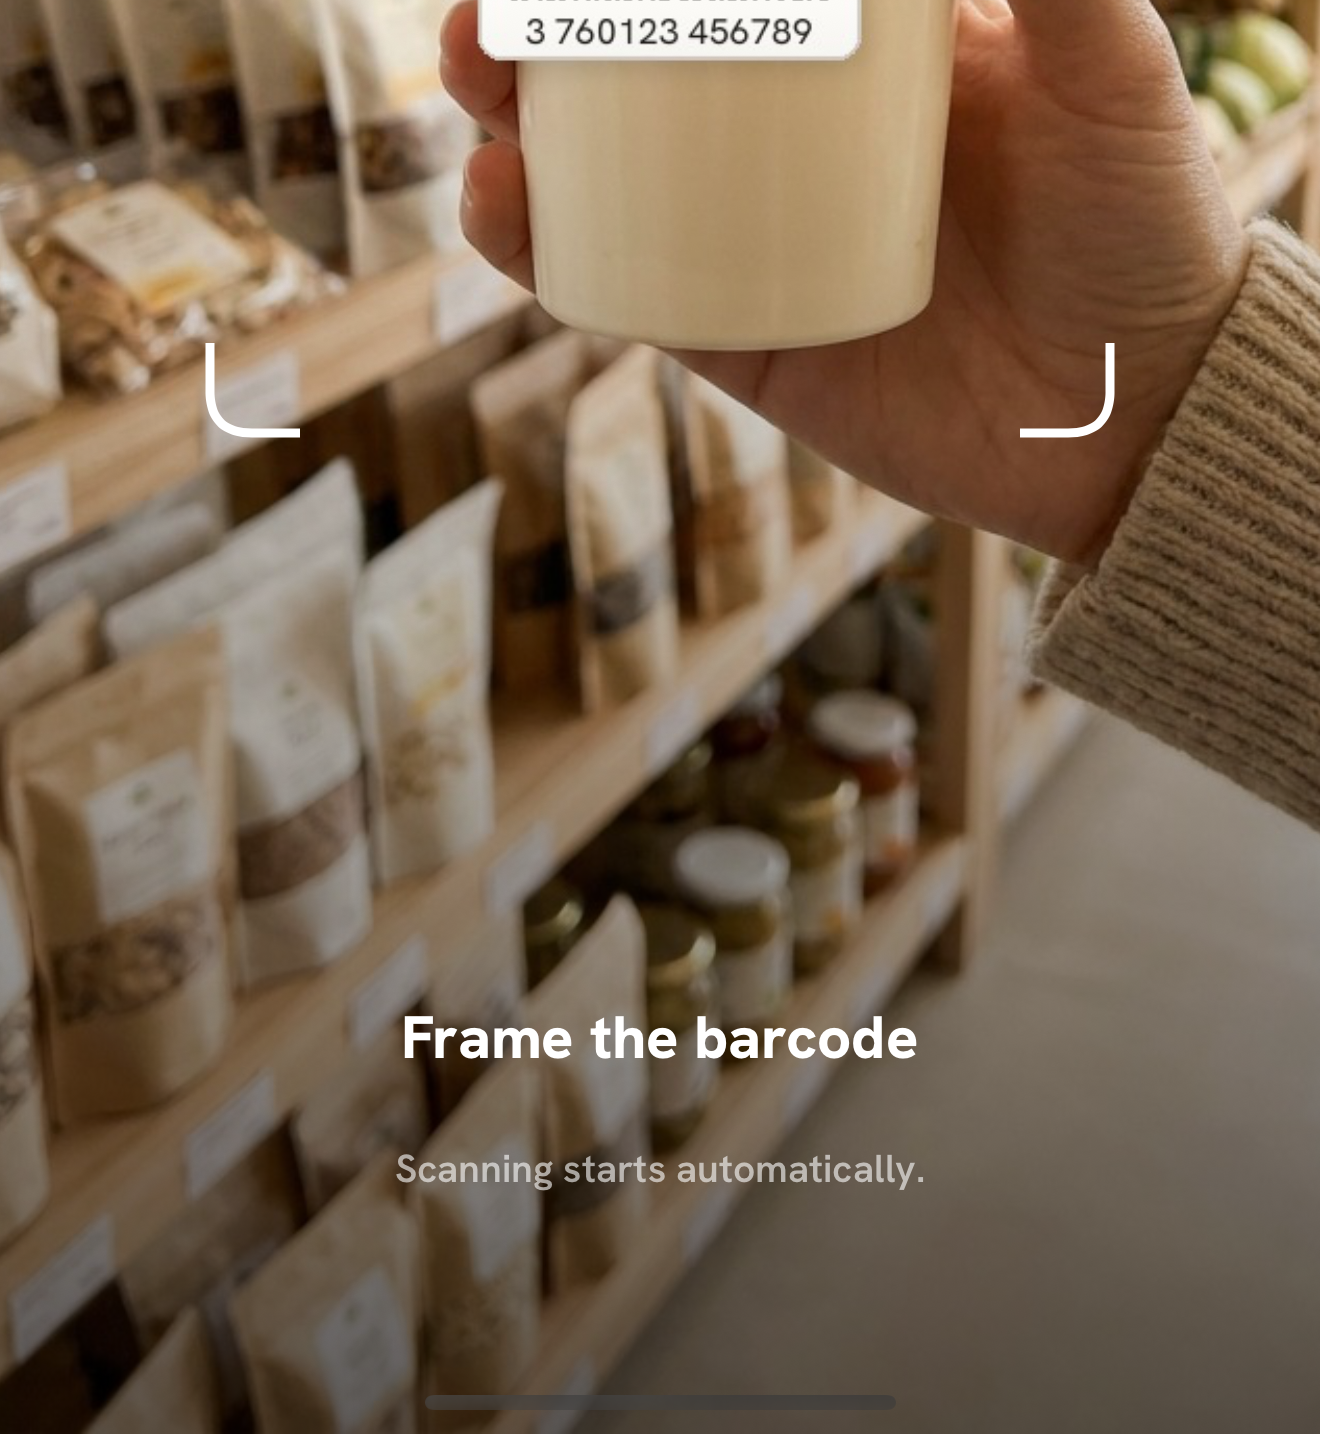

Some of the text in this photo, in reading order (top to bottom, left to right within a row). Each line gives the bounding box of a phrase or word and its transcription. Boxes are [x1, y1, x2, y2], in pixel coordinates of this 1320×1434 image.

[526, 18, 812, 45] 3 760123 456789
